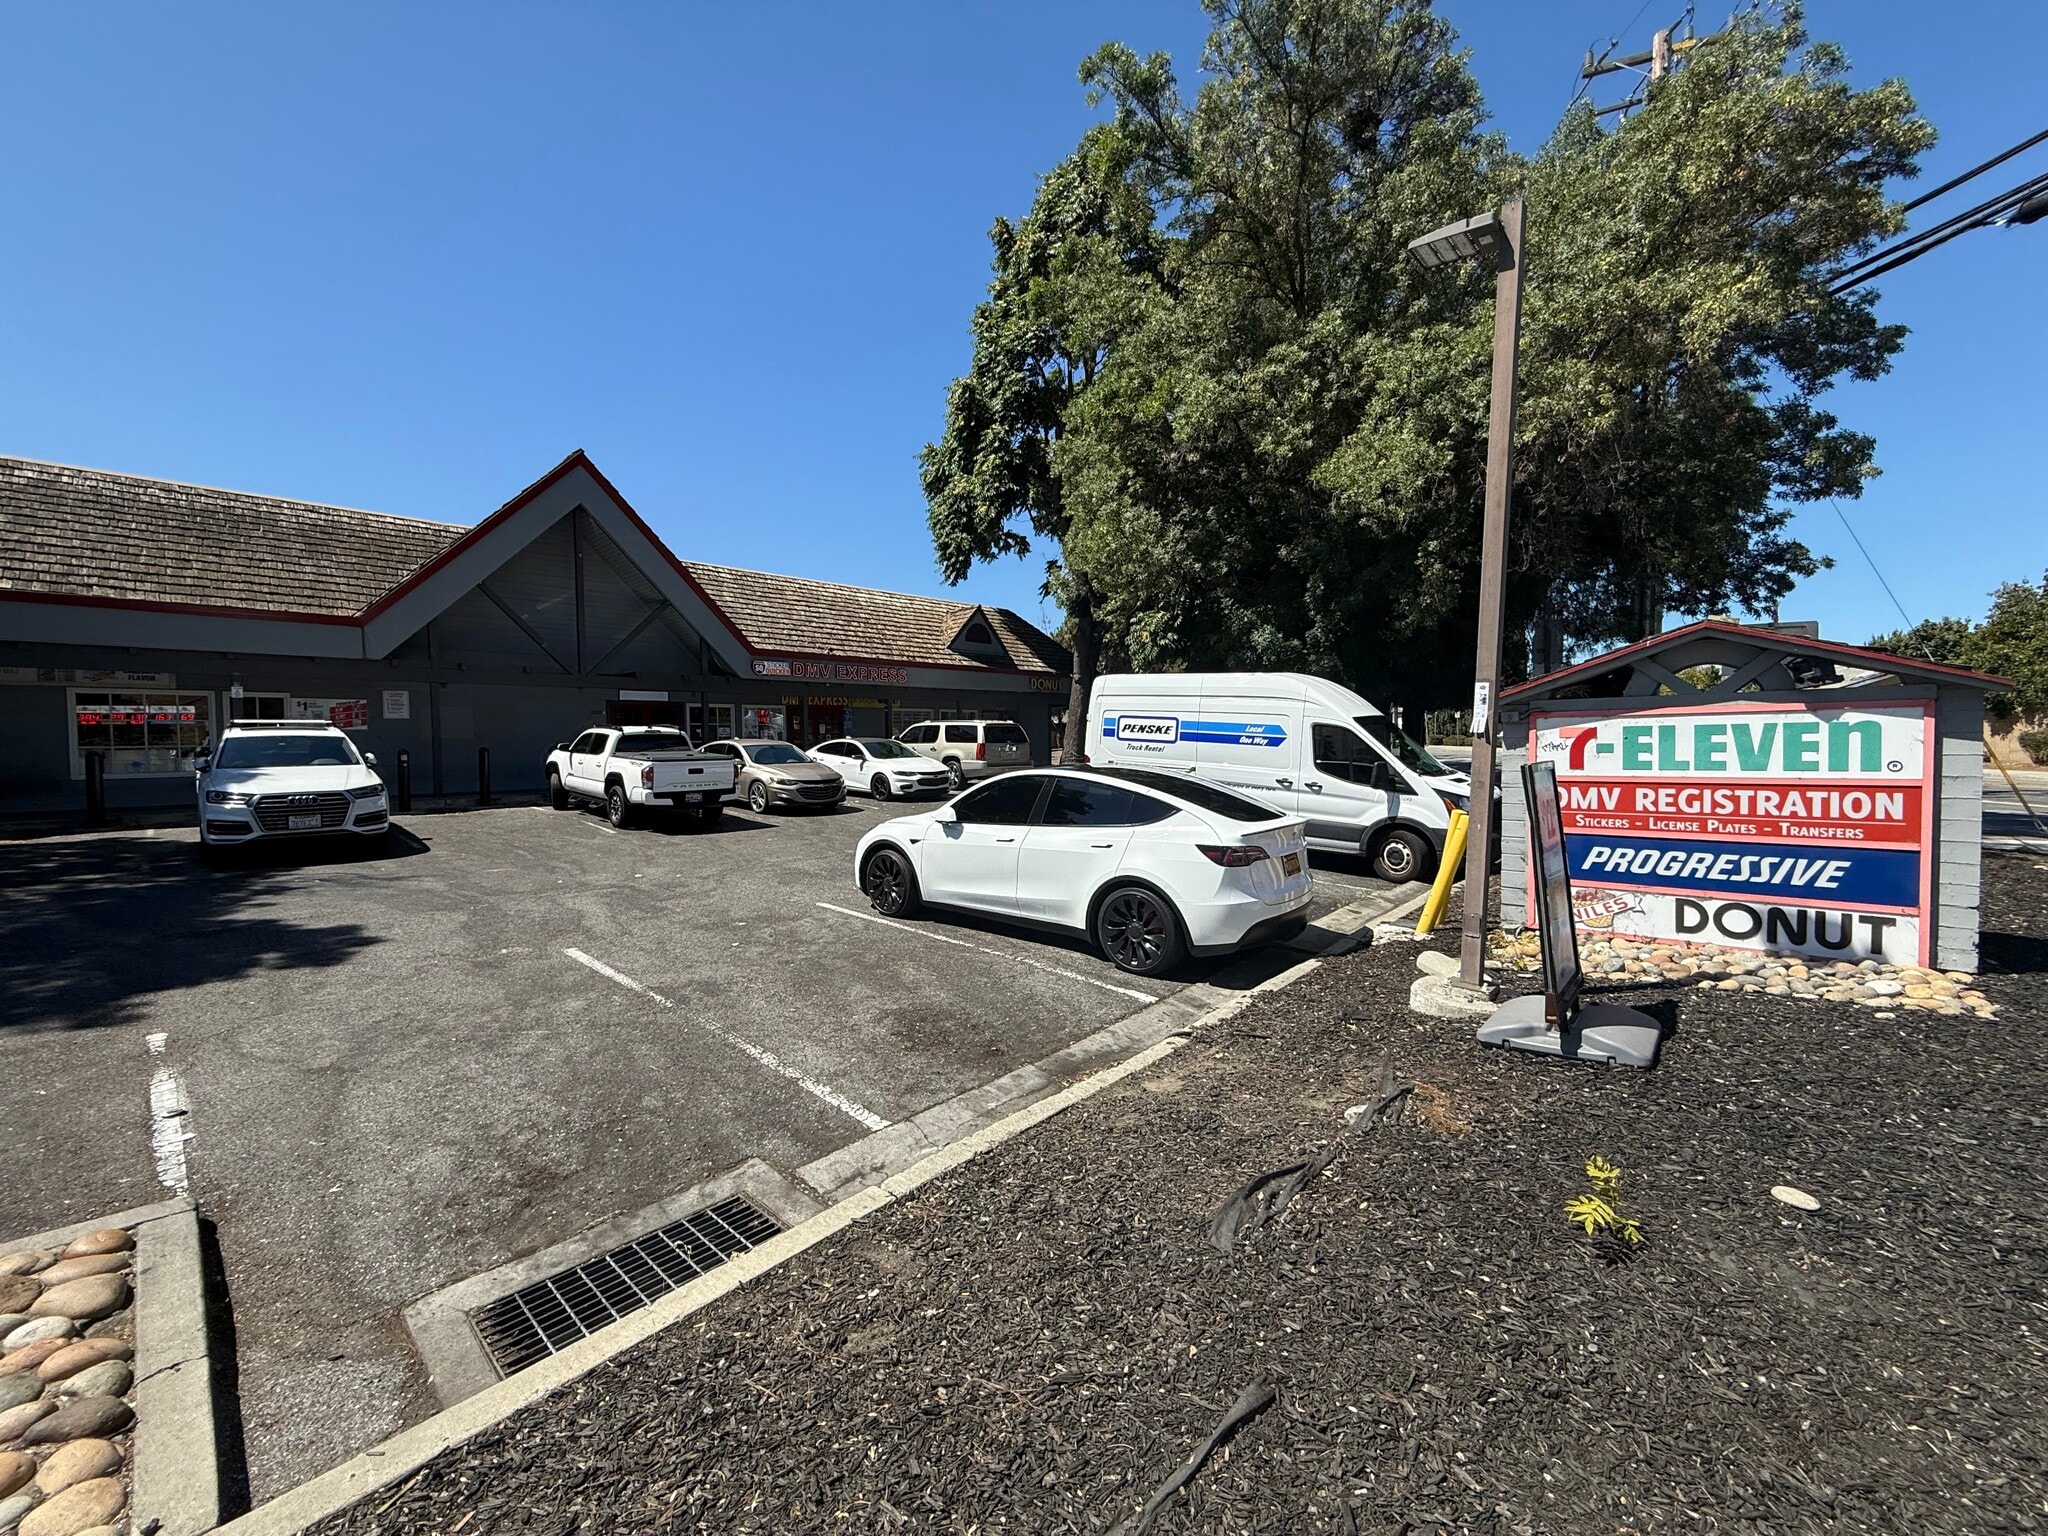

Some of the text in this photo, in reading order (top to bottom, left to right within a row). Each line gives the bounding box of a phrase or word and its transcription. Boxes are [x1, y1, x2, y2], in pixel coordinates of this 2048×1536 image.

[792, 662, 907, 683] DMV EXPRESS
[1031, 679, 1063, 690] DONUT
[1122, 724, 1174, 735] PENSKE
[1127, 743, 1166, 753] Truck Rental
[1253, 737, 1269, 746] Way
[1635, 788, 1904, 820] REGISTRATION
[1575, 814, 1630, 828] STICKERS
[1649, 817, 1700, 832] LICENSE
[1707, 819, 1757, 835] PLATES
[1779, 822, 1864, 839] TRANSFERS
[1581, 846, 1852, 889] PROGRESSIVE
[1675, 897, 1897, 956] DONUT
